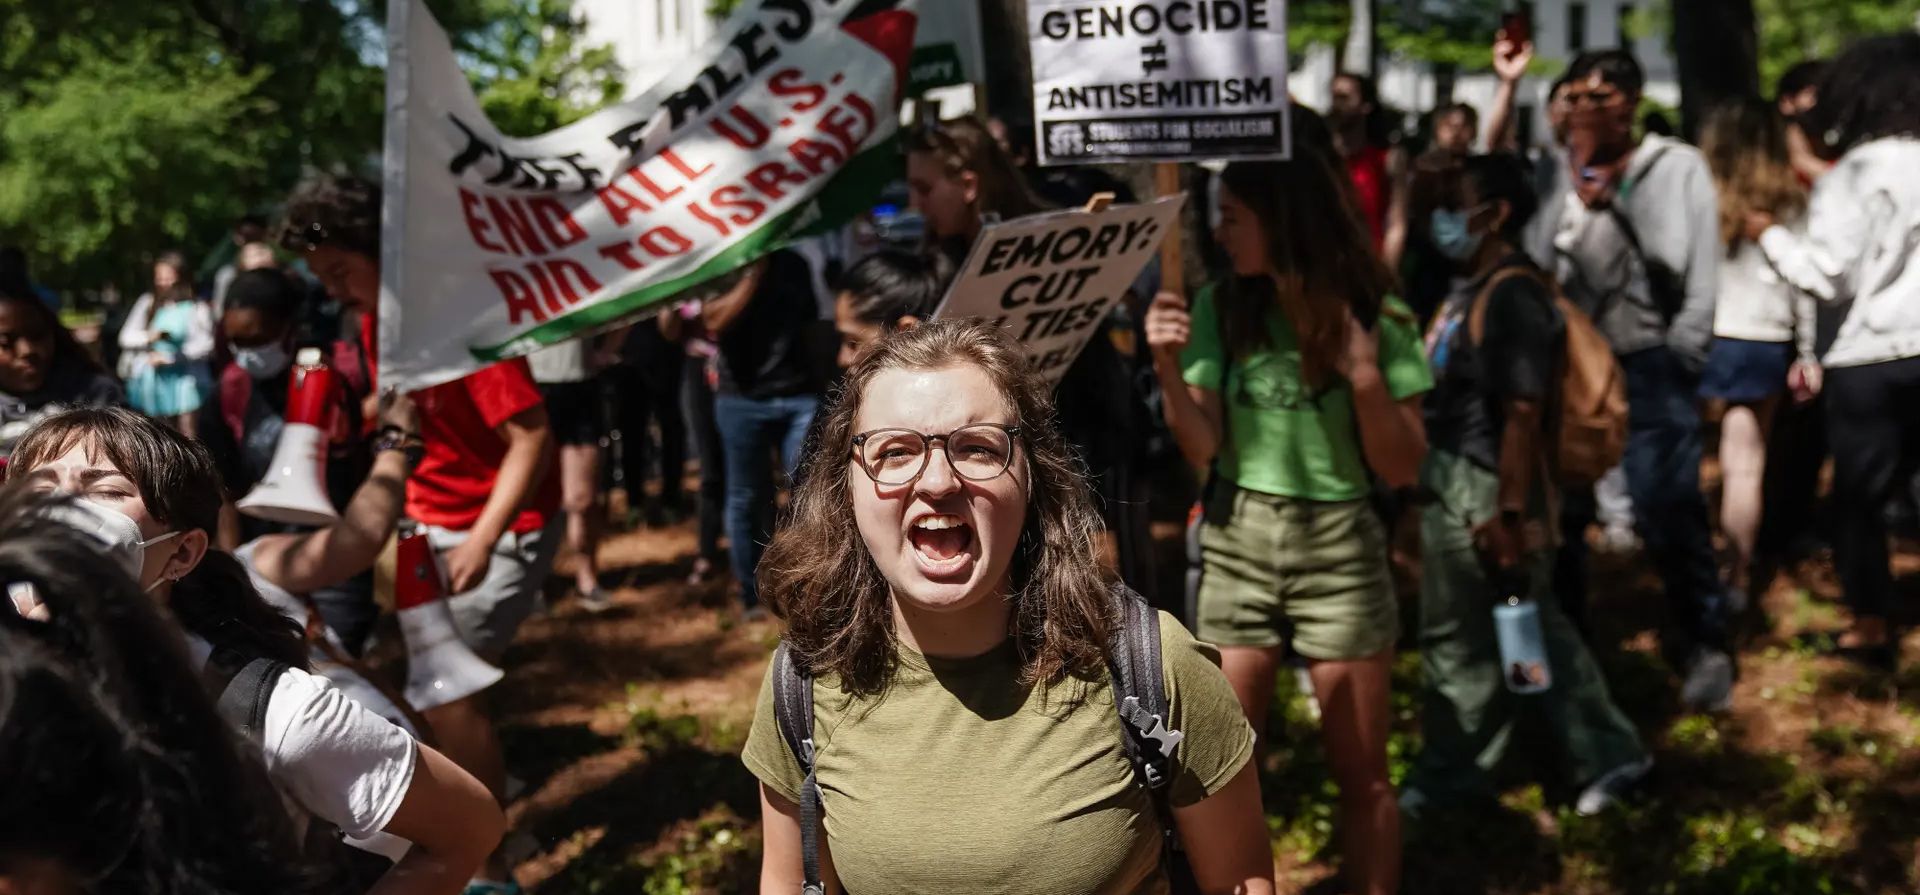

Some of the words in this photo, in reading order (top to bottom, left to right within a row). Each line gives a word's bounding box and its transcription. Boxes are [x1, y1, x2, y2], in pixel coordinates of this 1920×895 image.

[1041, 0, 1268, 40] GENOCIDE
[1049, 77, 1272, 110] ANTISEMITISM
[1088, 123, 1160, 141] STUDENTS
[1193, 120, 1275, 138] SOCIALISM
[459, 184, 588, 258] END
[598, 147, 714, 228] ALL
[708, 68, 844, 151] U.S.
[980, 217, 1158, 277] EMORY:
[488, 257, 603, 325] AID
[598, 225, 694, 271] TO
[1001, 266, 1102, 310] CUT
[1017, 298, 1107, 343] TIES
